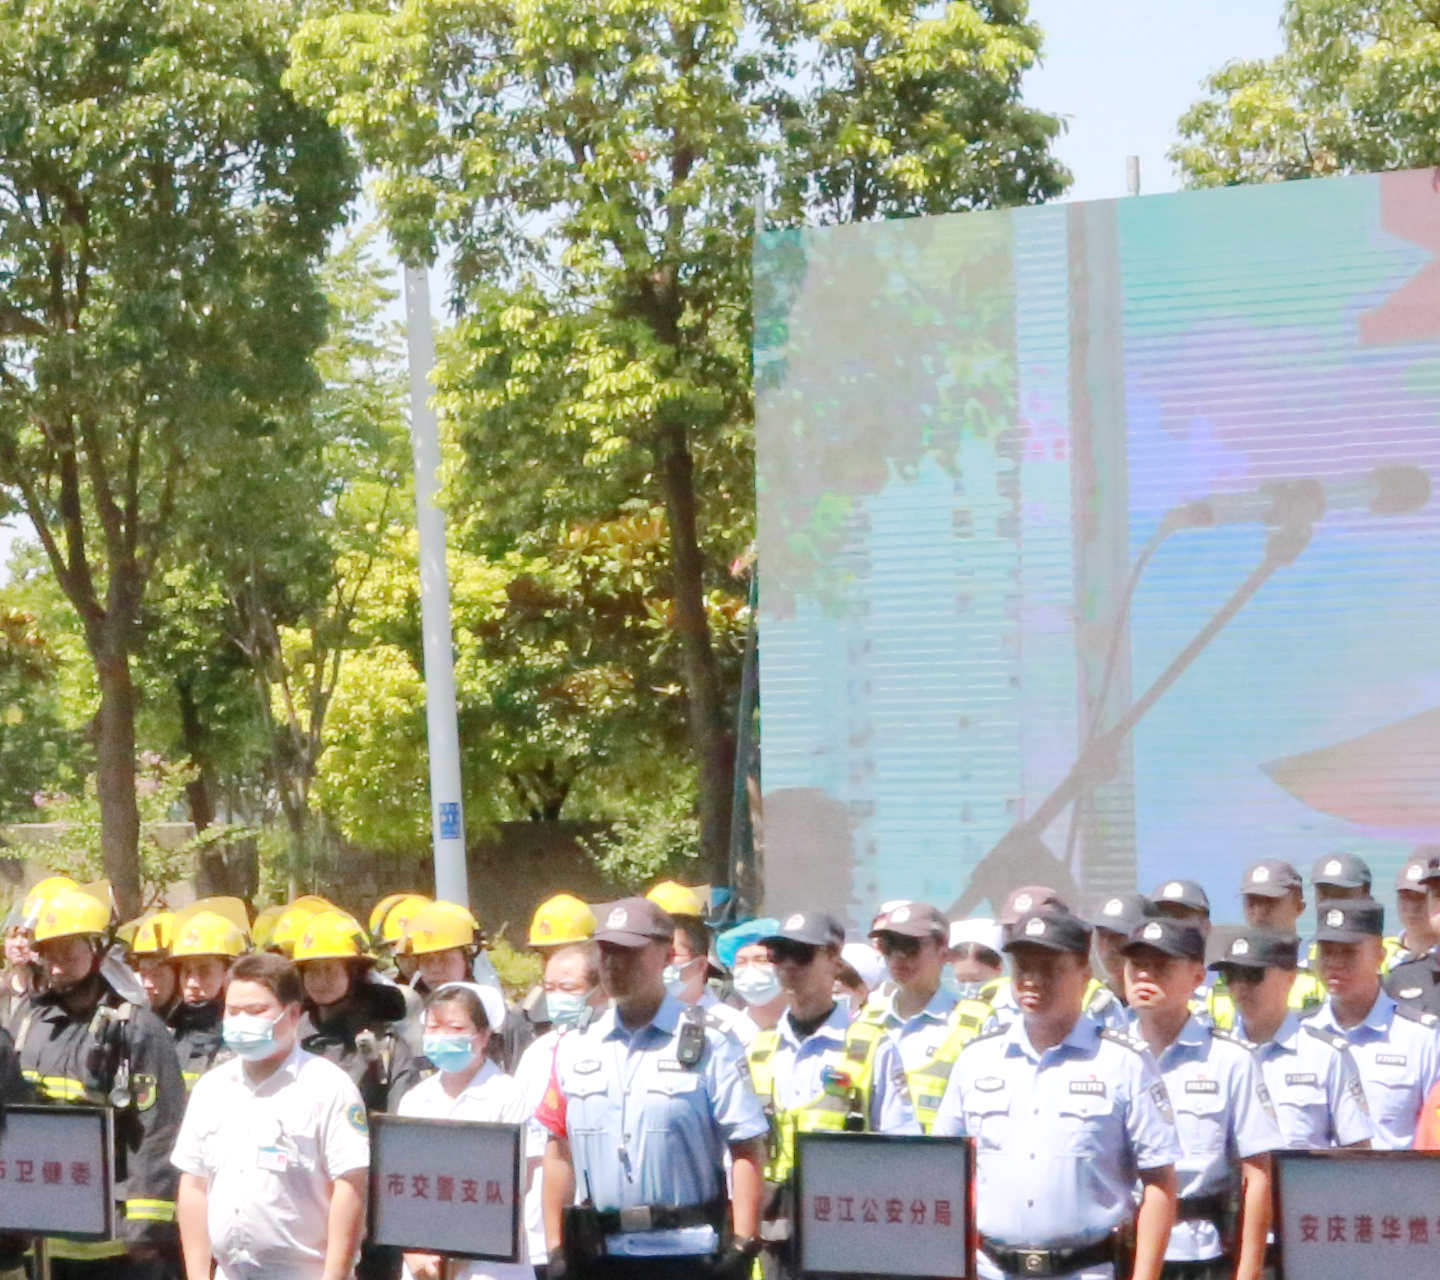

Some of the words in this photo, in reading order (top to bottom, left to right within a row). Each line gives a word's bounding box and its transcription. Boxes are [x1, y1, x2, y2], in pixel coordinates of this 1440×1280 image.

[386, 1173, 505, 1205] 市交警支队
[813, 1195, 952, 1226] 迎江公安分局
